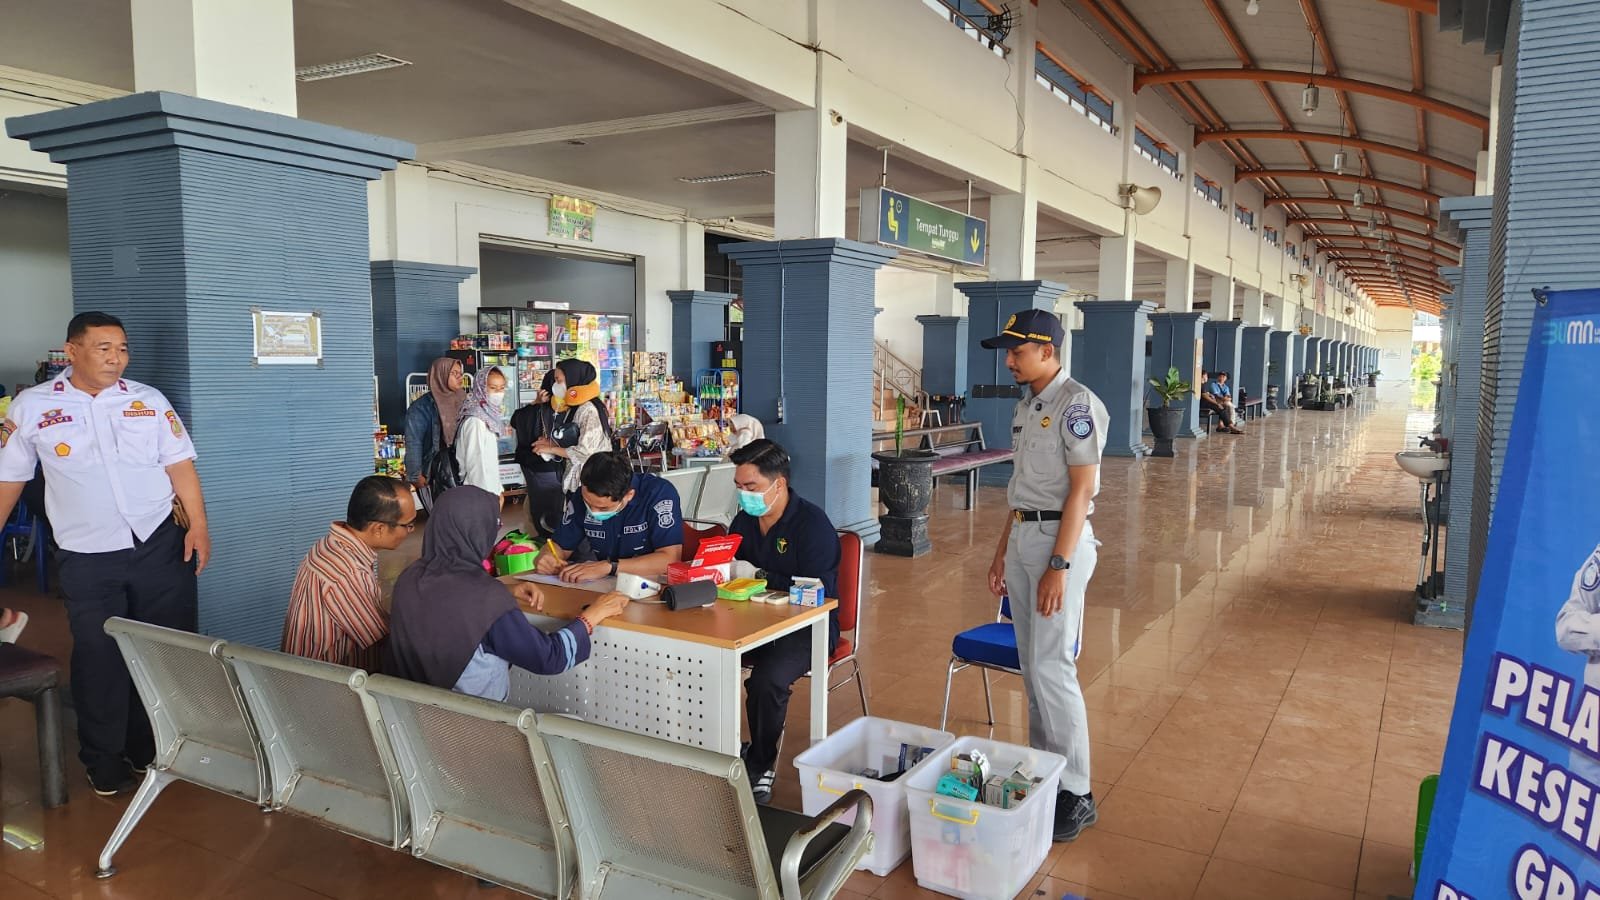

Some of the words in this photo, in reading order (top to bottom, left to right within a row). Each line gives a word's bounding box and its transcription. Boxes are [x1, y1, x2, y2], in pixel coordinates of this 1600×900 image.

[915, 217, 938, 237] Tempat
[939, 223, 959, 243] Tunggu
[626, 523, 647, 533] POLRI
